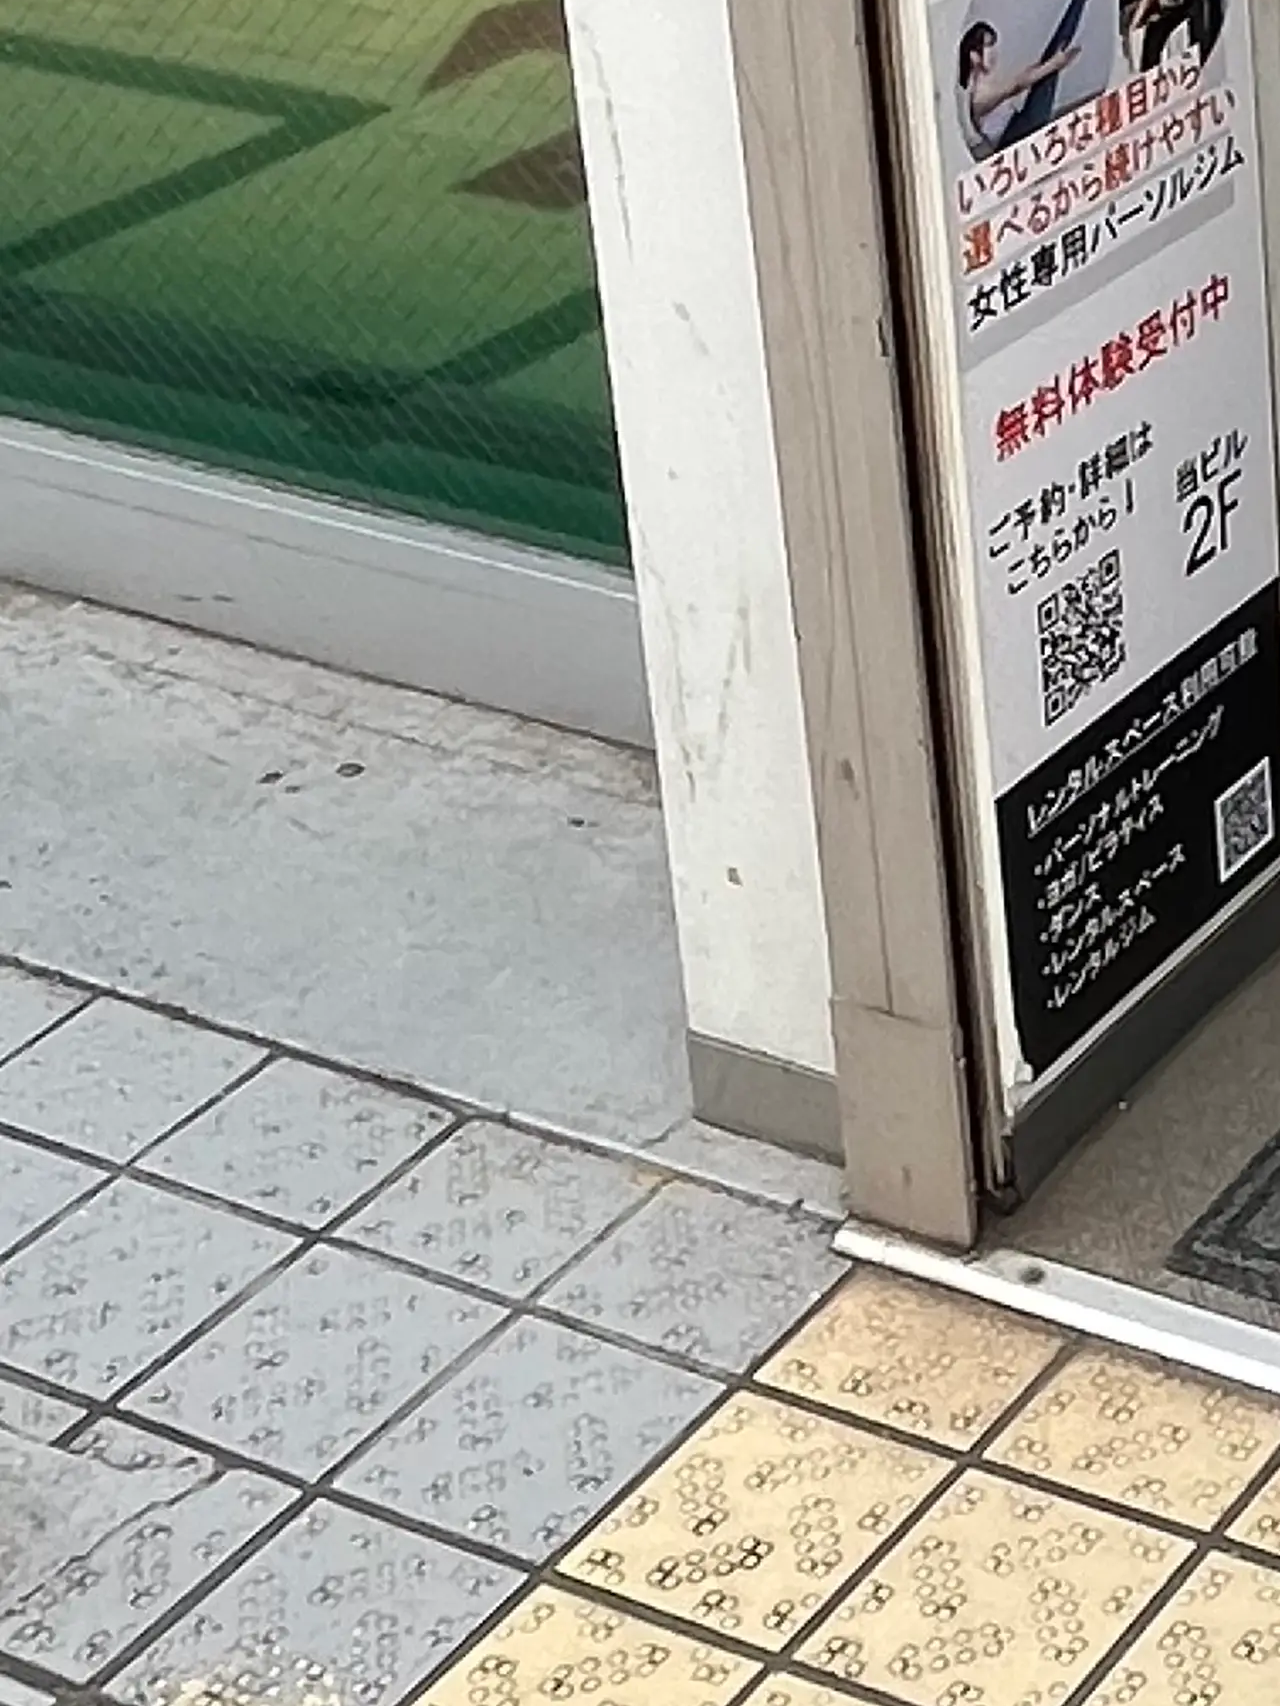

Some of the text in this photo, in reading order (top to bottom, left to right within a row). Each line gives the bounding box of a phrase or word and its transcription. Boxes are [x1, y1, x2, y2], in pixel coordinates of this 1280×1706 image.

[958, 64, 1200, 214] いろいろな種目から
[962, 88, 1236, 274] 選べるから続けやすい
[996, 273, 1229, 462] 無料体験受付中
[1175, 428, 1248, 503] 当ビル
[1182, 467, 1243, 577] 2F
